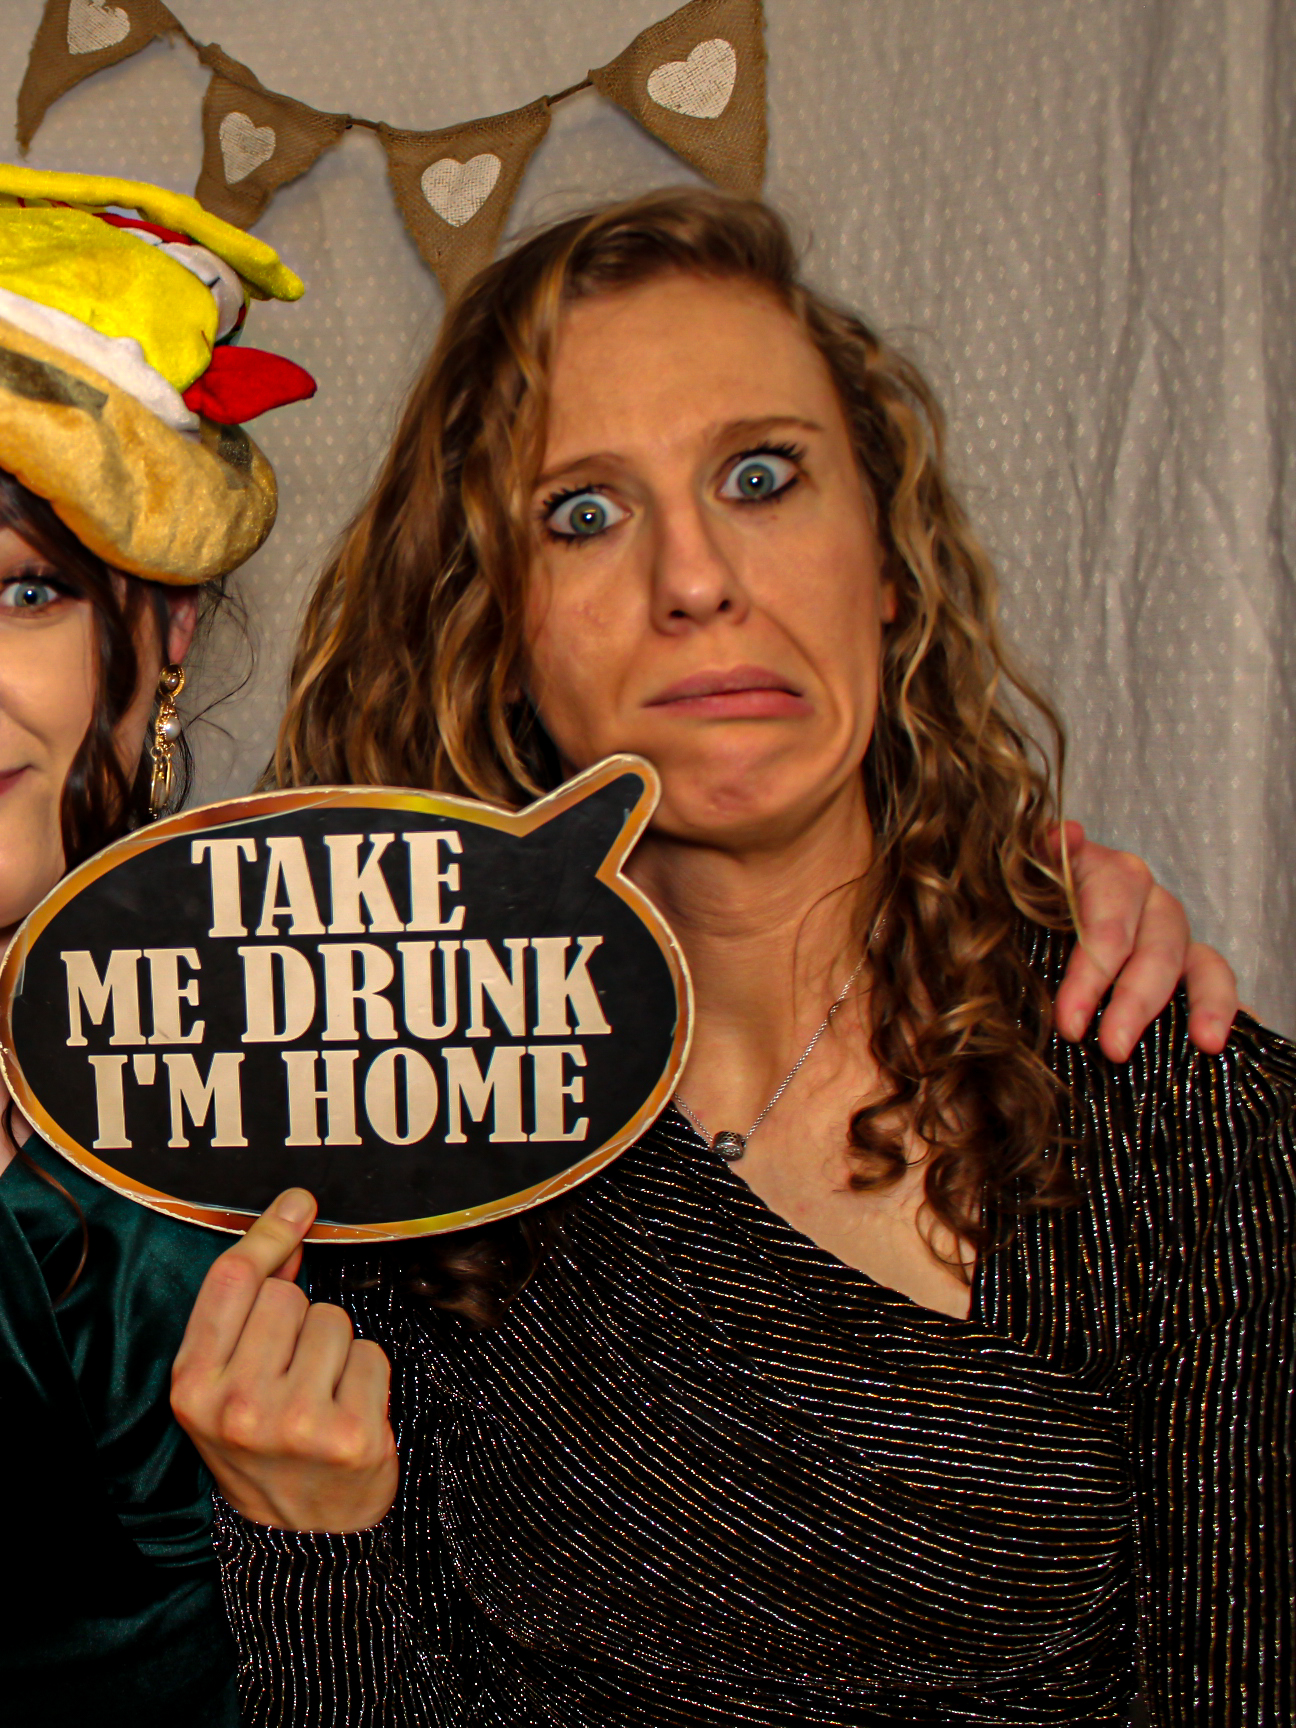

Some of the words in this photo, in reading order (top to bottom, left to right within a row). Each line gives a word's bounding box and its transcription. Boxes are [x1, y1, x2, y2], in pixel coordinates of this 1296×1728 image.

[191, 831, 465, 938] TAKE
[60, 948, 206, 1046] ME
[237, 936, 612, 1043] DRUNK
[88, 1052, 249, 1149] I'M
[281, 1045, 589, 1147] HOME
